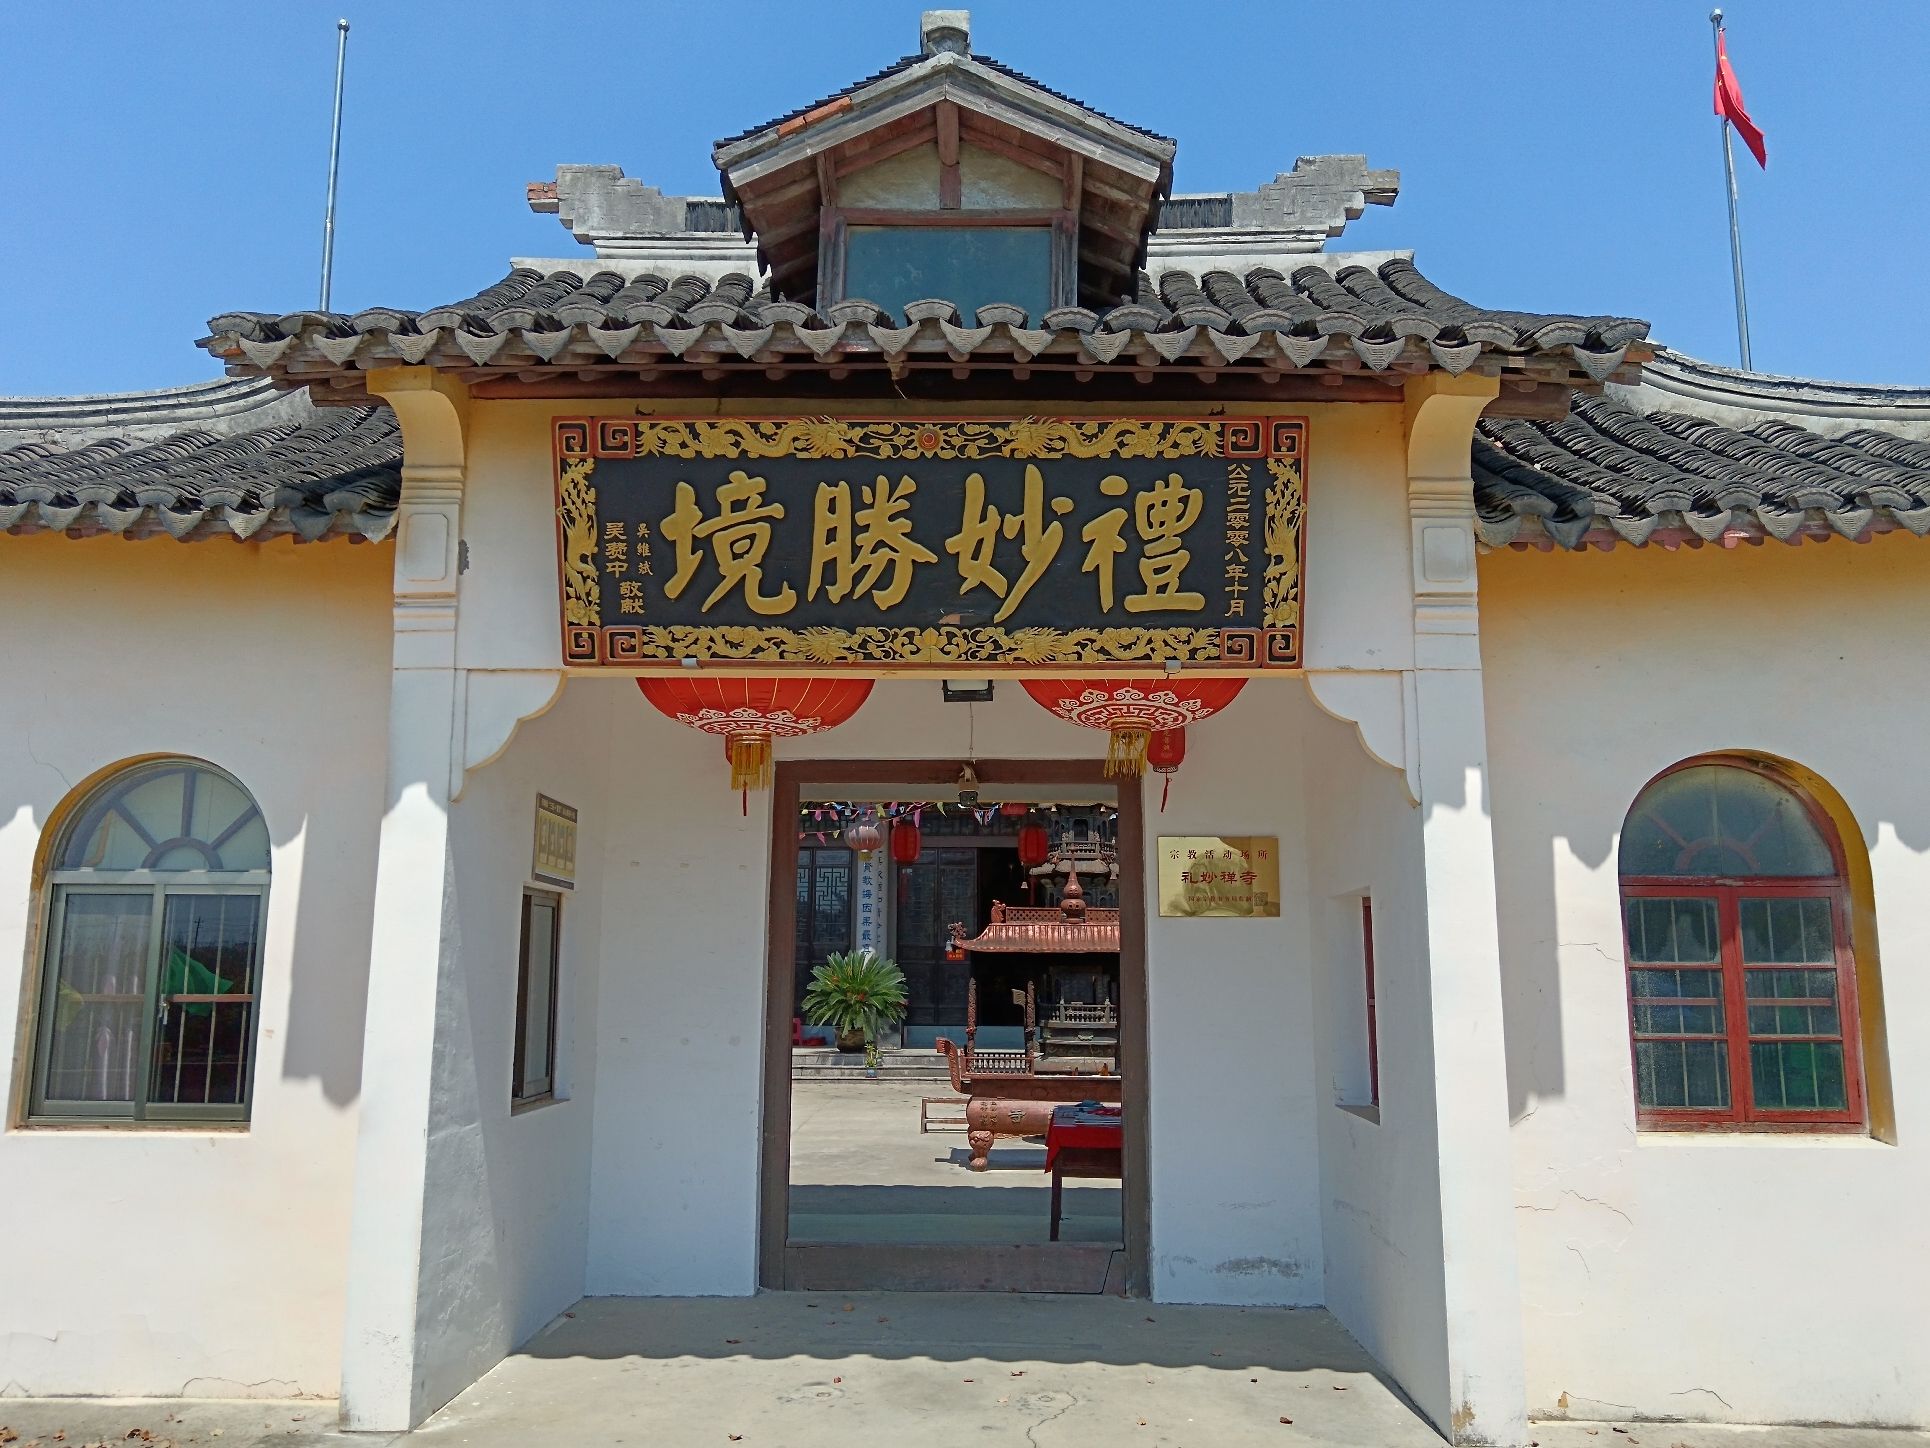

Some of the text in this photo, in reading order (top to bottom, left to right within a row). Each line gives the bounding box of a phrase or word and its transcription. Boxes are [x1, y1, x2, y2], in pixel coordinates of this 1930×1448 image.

[660, 463, 1206, 624] 禮妙勝境
[1225, 463, 1251, 617] 公元二零零八年十月
[1169, 849, 1268, 860] 宗教活动场所
[1181, 871, 1257, 885] 礼妙禅寺
